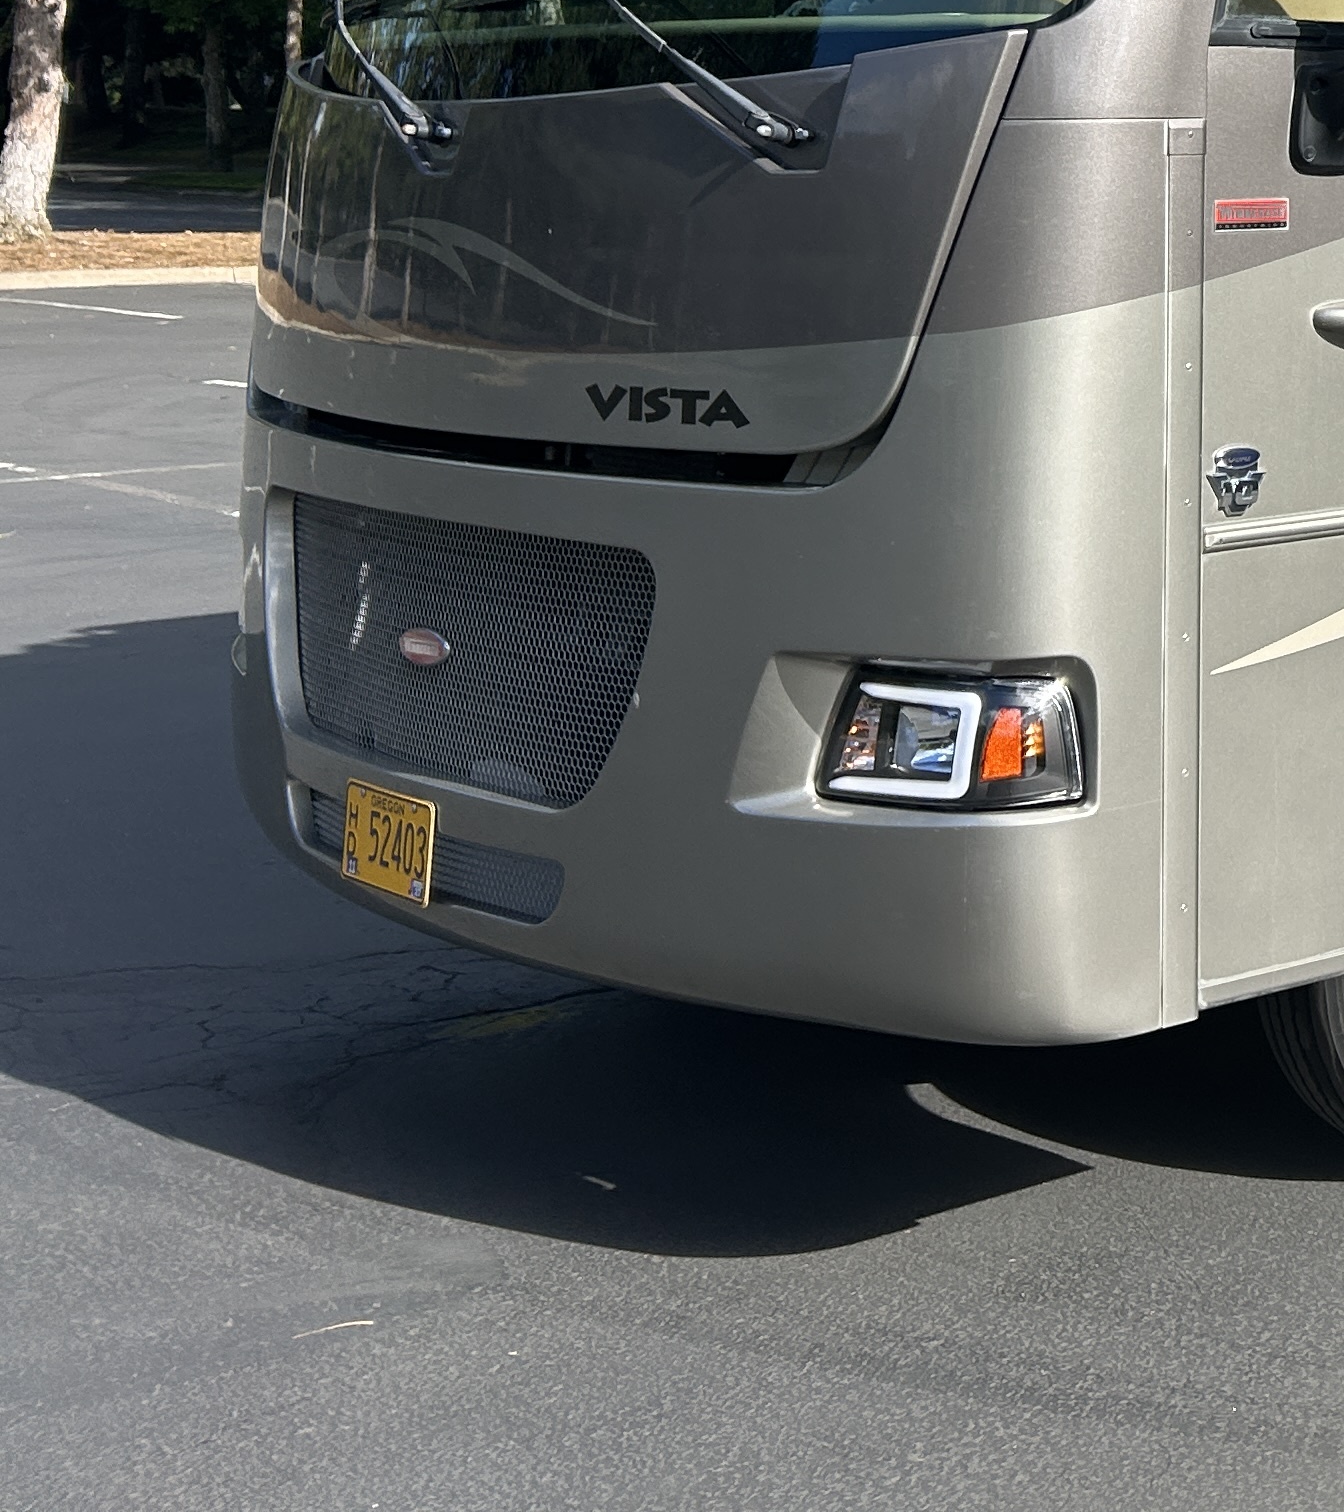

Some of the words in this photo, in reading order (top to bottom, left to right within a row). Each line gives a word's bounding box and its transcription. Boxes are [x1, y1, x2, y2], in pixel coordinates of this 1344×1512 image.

[585, 383, 750, 429] VISTA
[371, 794, 405, 815] OREGON
[368, 810, 427, 879] 52403
